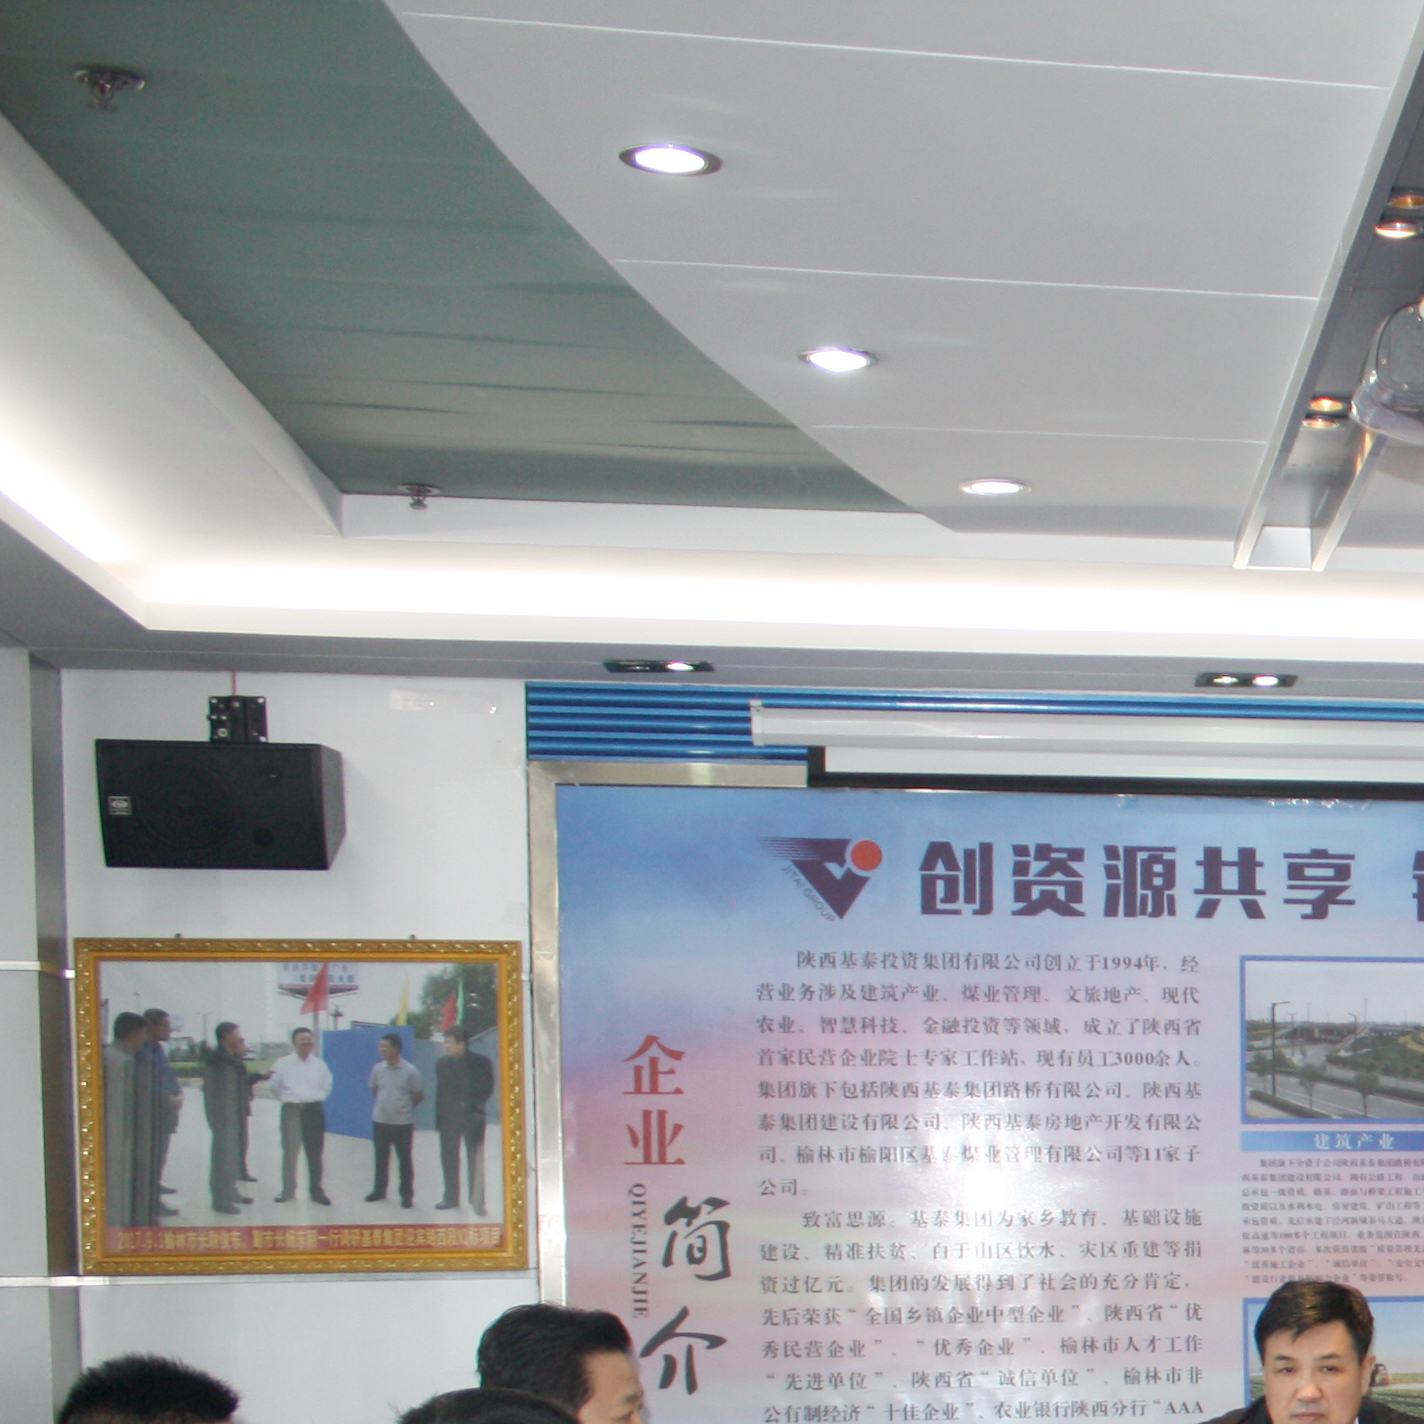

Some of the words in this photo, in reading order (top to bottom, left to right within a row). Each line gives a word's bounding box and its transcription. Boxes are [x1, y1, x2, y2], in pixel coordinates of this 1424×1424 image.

[802, 887, 835, 921] GROUP
[919, 840, 1356, 920] 创资源共享
[622, 1035, 686, 1165] 企业
[1313, 1132, 1395, 1150] 建筑产业
[628, 1183, 649, 1319] QIYEJIANJIE
[639, 1196, 732, 1395] 简介
